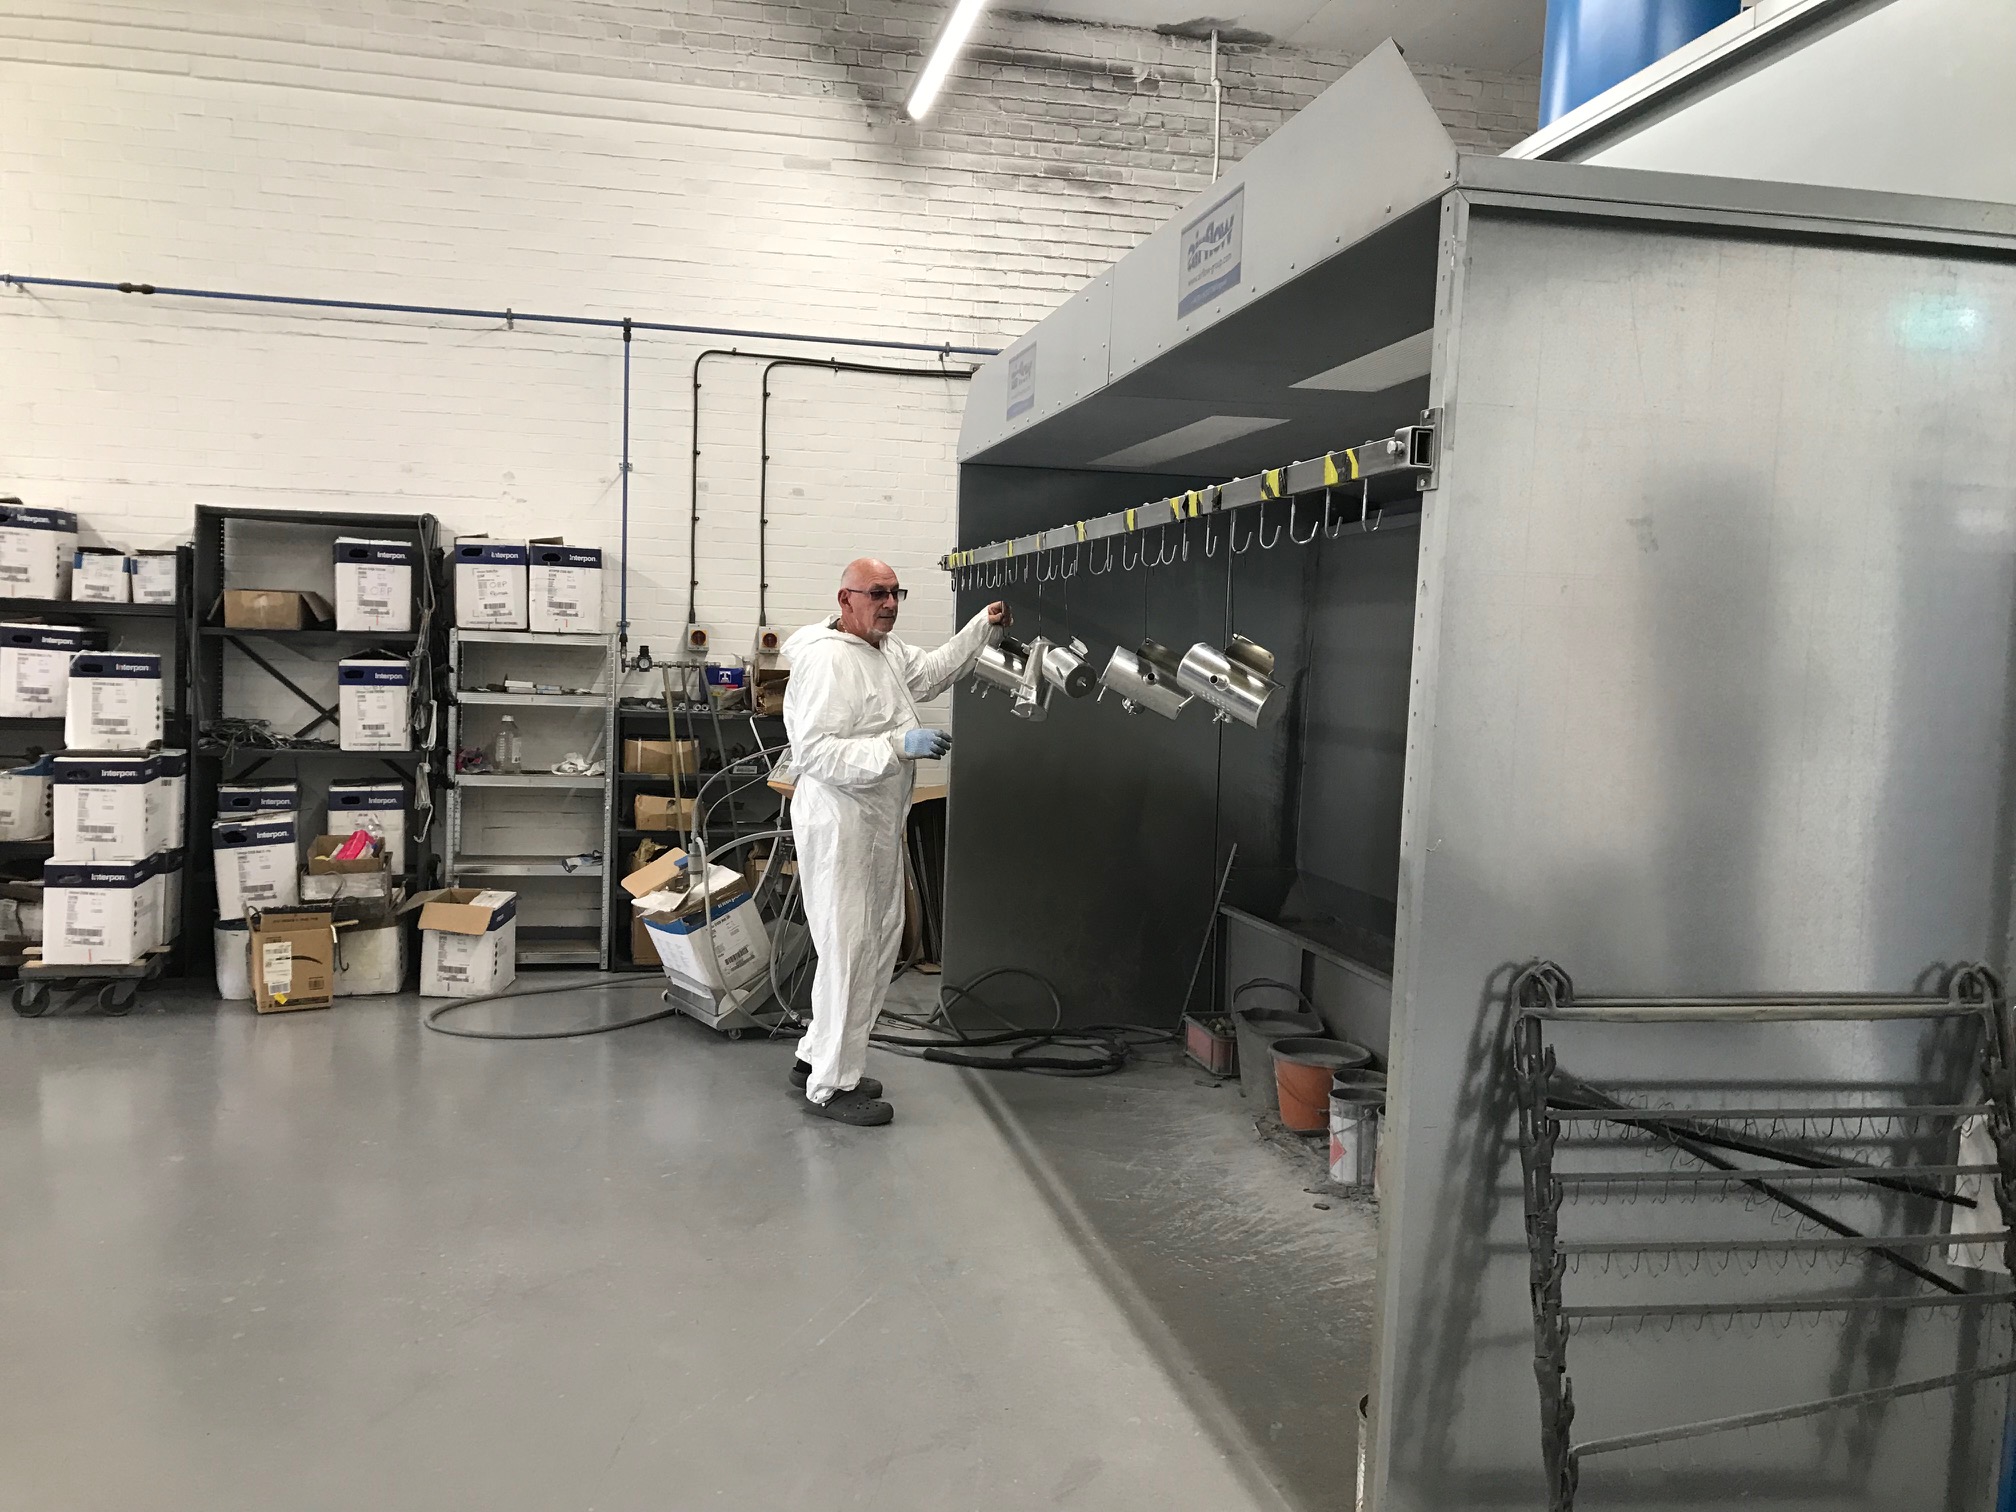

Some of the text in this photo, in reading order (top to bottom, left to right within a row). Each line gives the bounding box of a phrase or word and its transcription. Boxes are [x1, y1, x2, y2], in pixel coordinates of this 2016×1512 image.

[1186, 213, 1235, 272] airflow
[377, 551, 405, 560] Interpon
[41, 636, 74, 646] Interpon
[115, 663, 149, 672] Interpon
[375, 672, 402, 680] Interpon
[101, 769, 136, 778] Interpon
[261, 798, 290, 806] Interpon
[368, 797, 396, 805] Interpon
[256, 830, 288, 840] Interpon
[91, 873, 126, 882] Interpon
